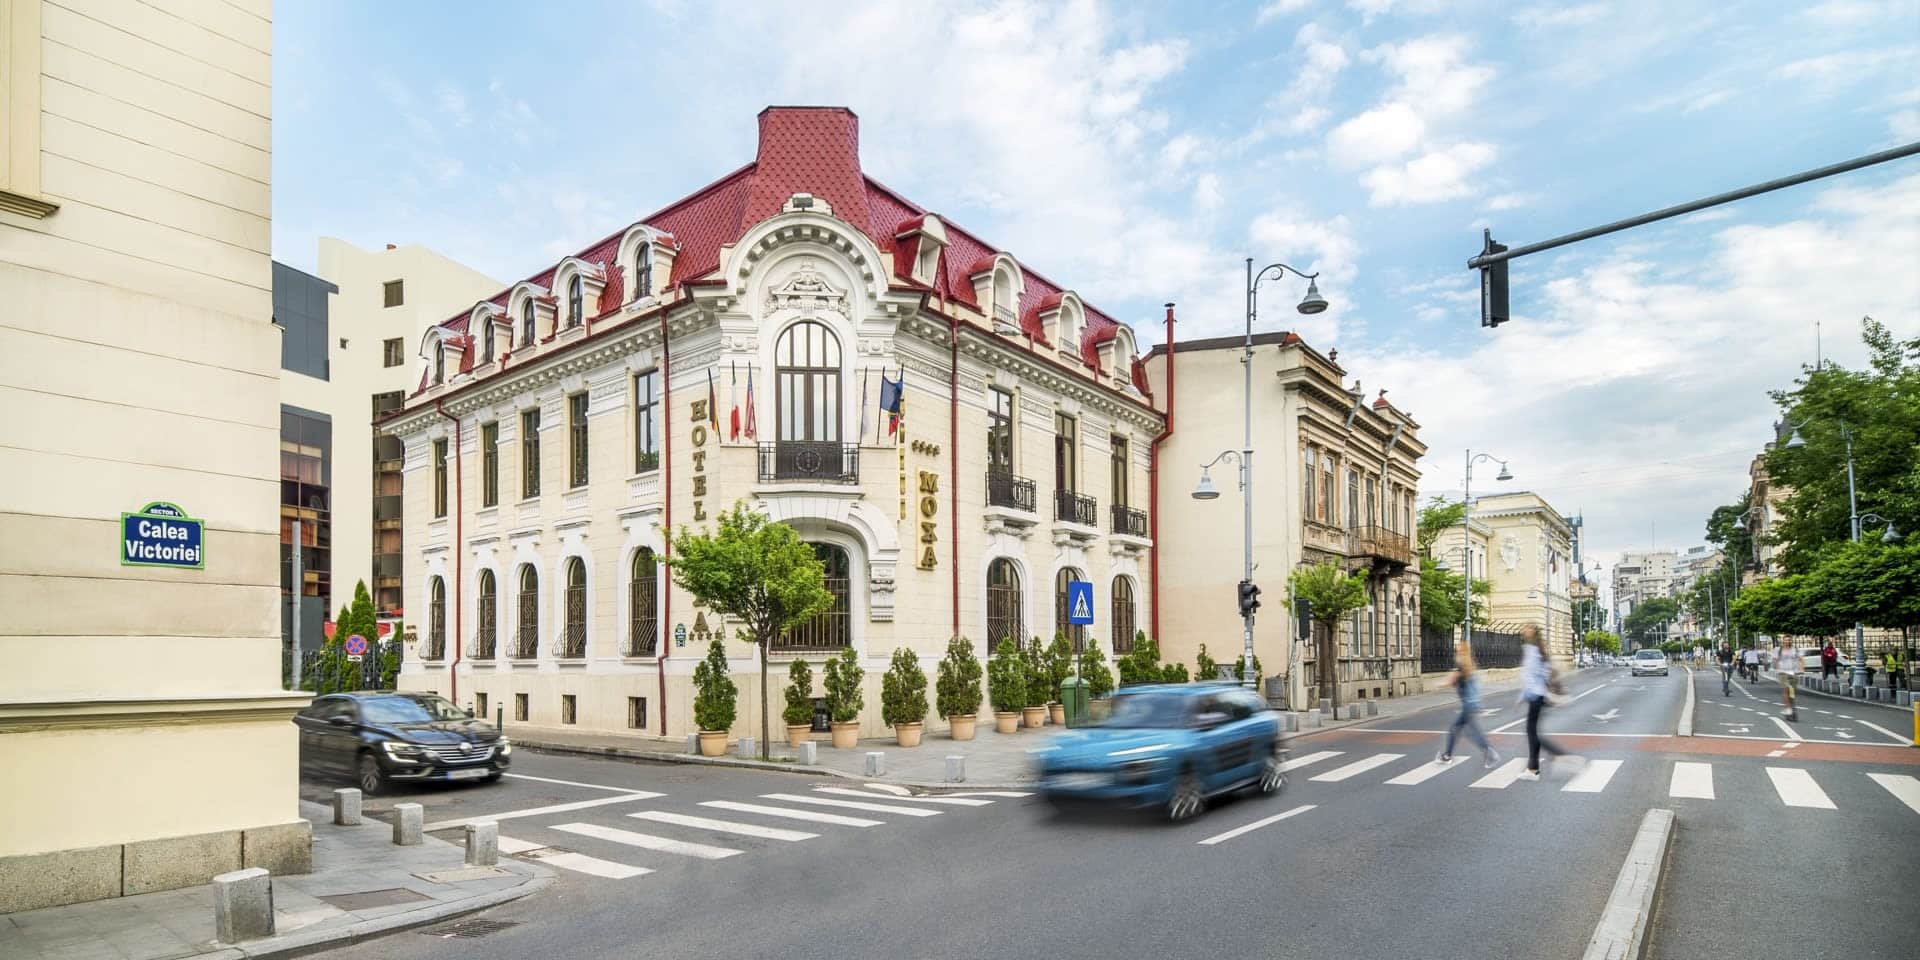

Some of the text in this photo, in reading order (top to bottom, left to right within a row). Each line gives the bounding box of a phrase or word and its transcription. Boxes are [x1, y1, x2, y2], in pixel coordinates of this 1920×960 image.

[691, 399, 707, 521] HOTEL
[150, 508, 174, 516] SECTOR
[919, 471, 939, 567] MOXA
[139, 520, 188, 540] Calea
[126, 540, 200, 561] Victoriei
